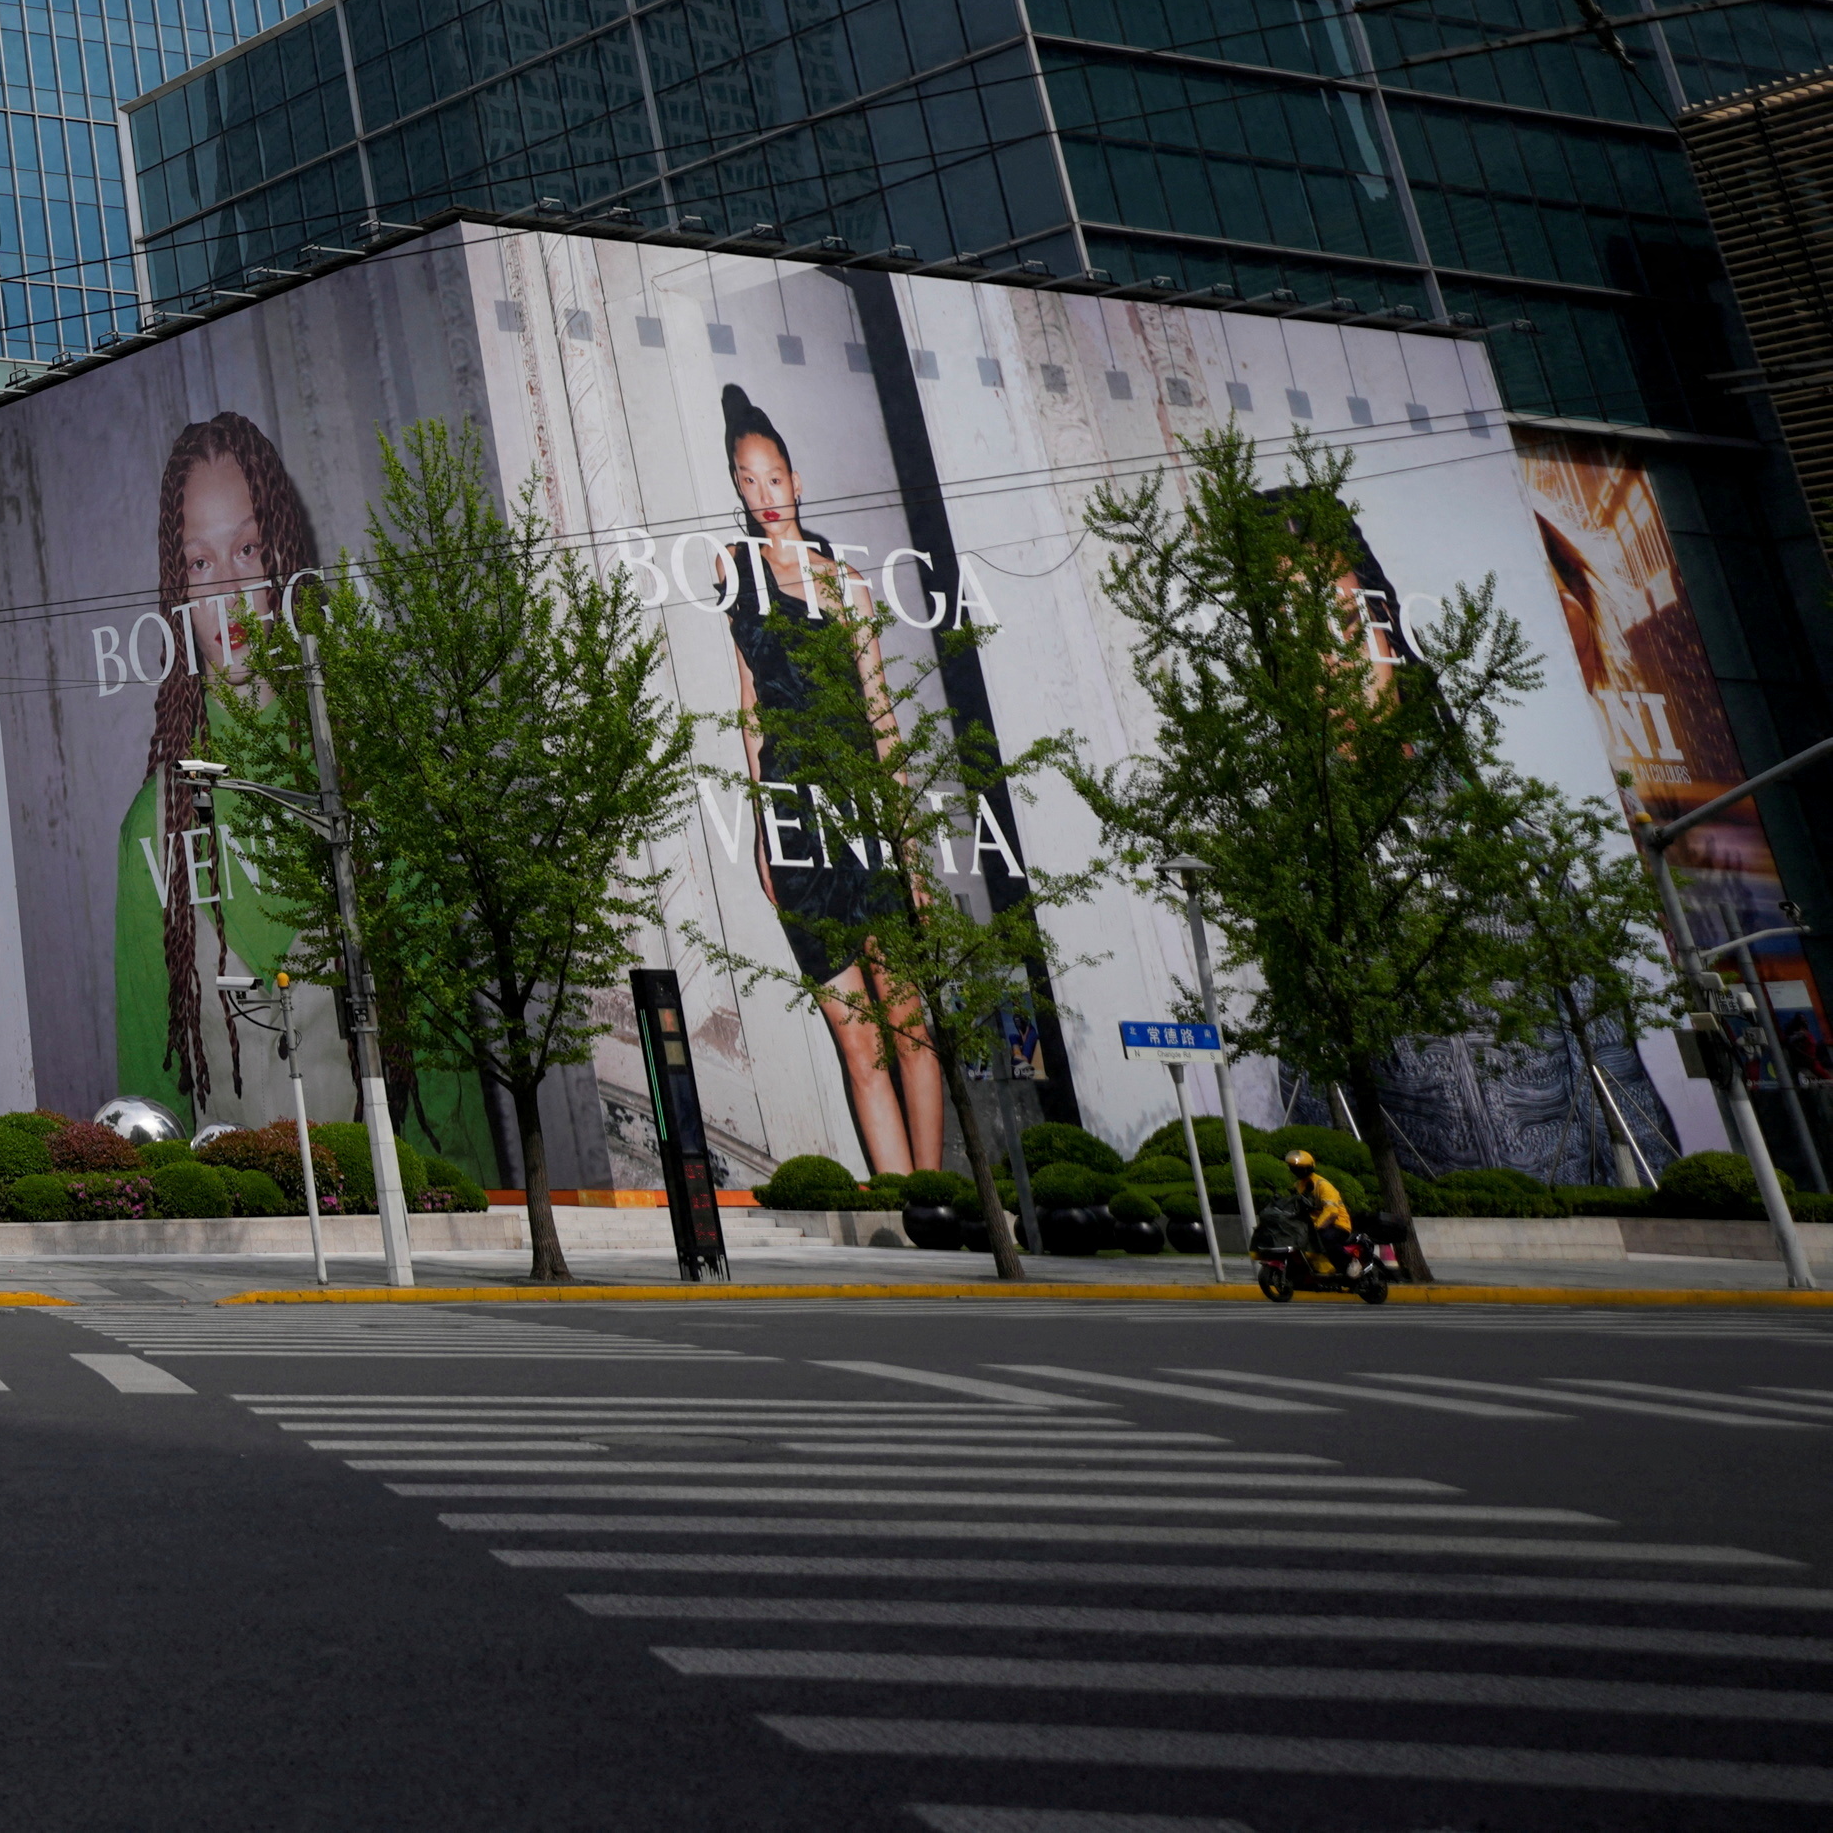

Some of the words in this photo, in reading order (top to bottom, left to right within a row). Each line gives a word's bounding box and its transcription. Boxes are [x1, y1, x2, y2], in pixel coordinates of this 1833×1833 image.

[614, 525, 1005, 634] BOTTEGA
[1147, 1026, 1195, 1046] 常德路
